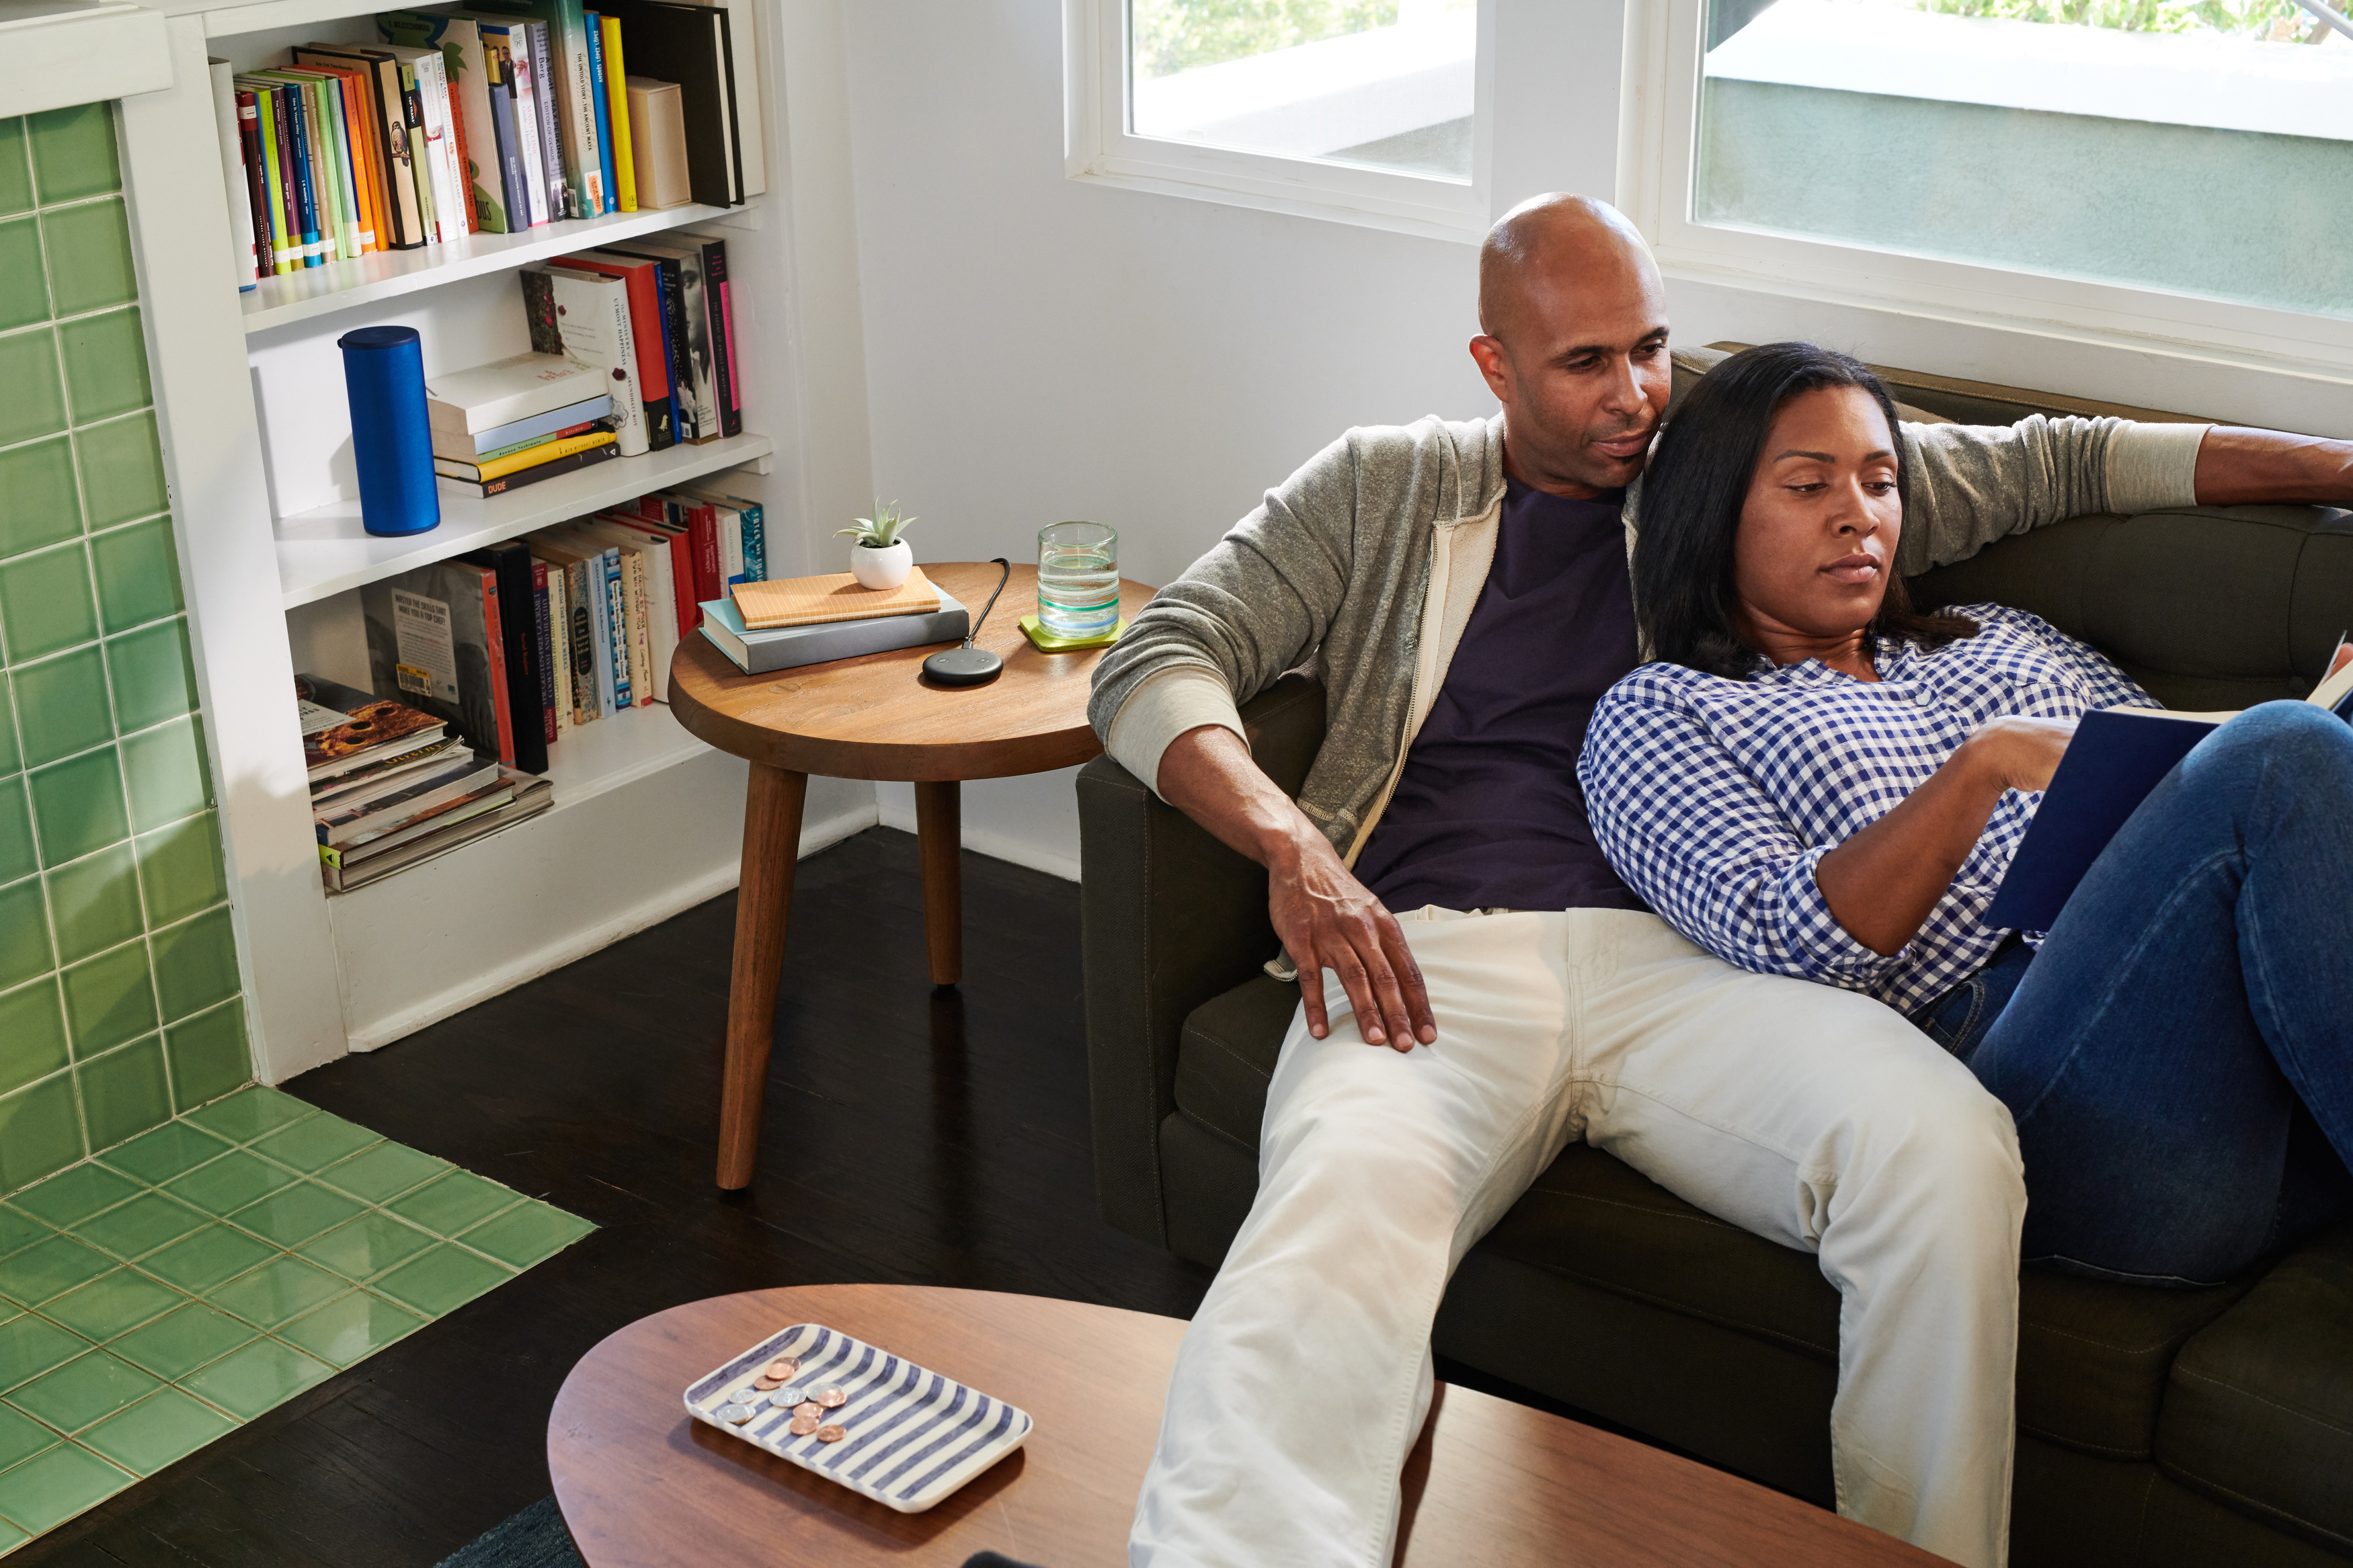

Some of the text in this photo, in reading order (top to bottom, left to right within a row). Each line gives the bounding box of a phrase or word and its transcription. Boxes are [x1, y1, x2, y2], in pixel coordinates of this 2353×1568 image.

[437, 63, 440, 71] ON
[546, 67, 554, 90] Scott
[453, 112, 462, 151] DRUCKERMAN
[547, 126, 552, 135] OF
[553, 122, 563, 159] PERKINS
[614, 298, 627, 366] UTMOST HAPPINESS
[622, 315, 630, 349] MINISTRY
[627, 376, 635, 413] ARUNDHATI
[518, 440, 541, 450] Yoshimoto
[487, 481, 506, 494] DUDE
[395, 594, 446, 616] MASTER THE SKILLS THAT
[399, 604, 410, 615] MAKE
[411, 608, 420, 618] YOU
[425, 612, 433, 622] TOP
[433, 615, 445, 626] CHEF!
[534, 594, 543, 634] GOURMET
[639, 600, 644, 608] SO
